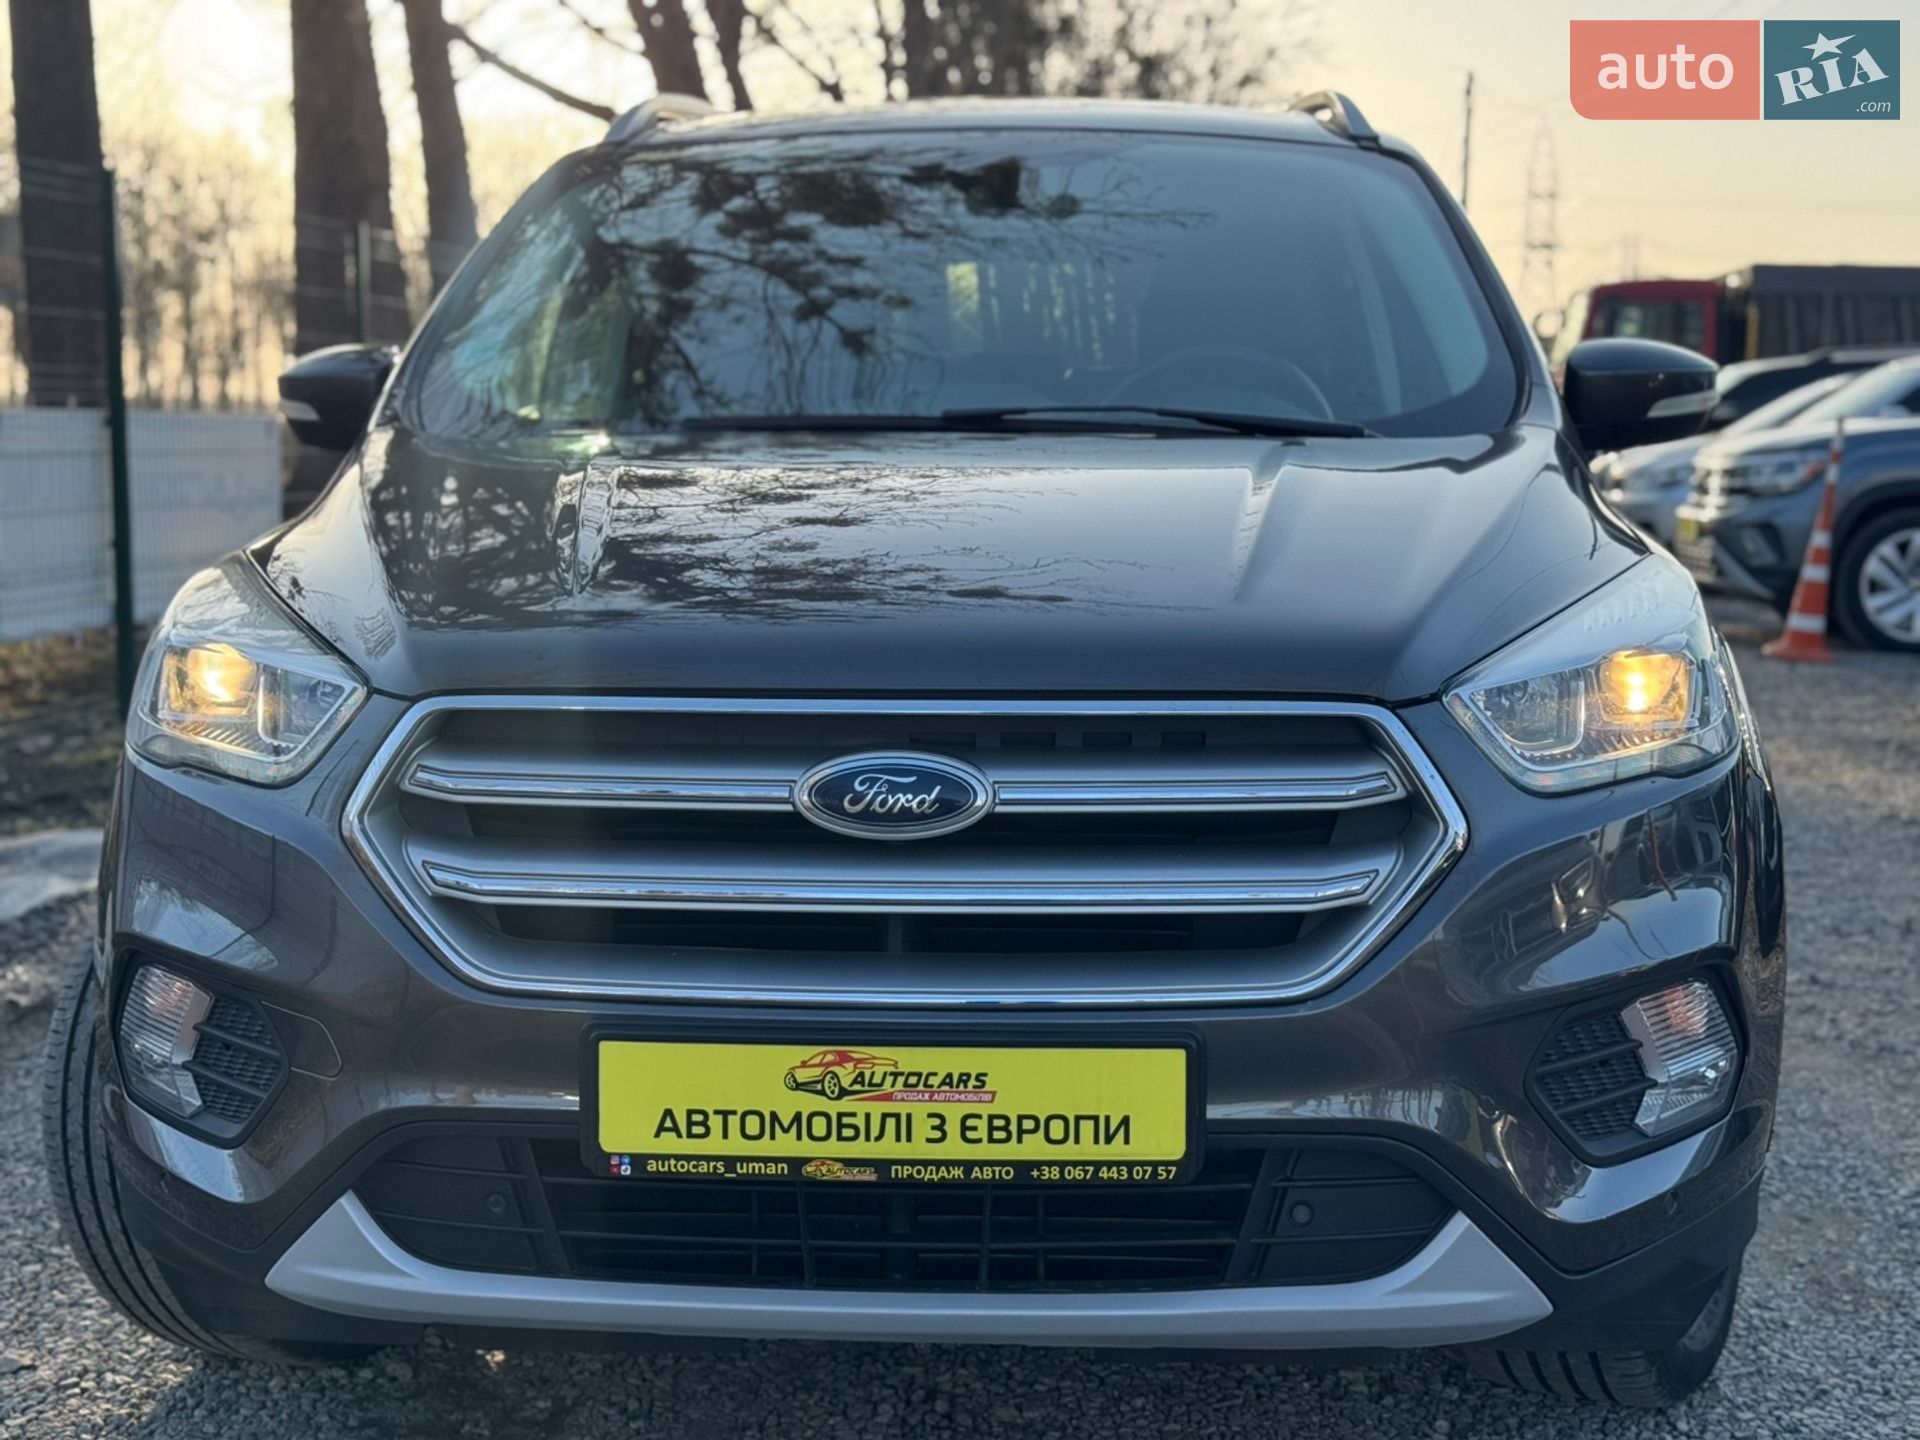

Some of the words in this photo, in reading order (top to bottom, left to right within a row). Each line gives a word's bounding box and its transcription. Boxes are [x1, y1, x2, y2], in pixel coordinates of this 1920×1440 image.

[843, 773, 942, 815] Ford
[848, 1070, 989, 1090] AUTOCARS
[653, 1107, 913, 1143] АВТОМОБІЛІ
[959, 1113, 1131, 1146] ЄВРОПИ
[646, 1157, 789, 1178] autocars_uman
[891, 1165, 964, 1181] ПРОДАЖ
[970, 1166, 1015, 1181] АВТО
[1030, 1167, 1060, 1181] +38
[1064, 1166, 1093, 1181] 067
[1098, 1167, 1128, 1181] 443
[1133, 1167, 1152, 1181] 07
[1157, 1167, 1177, 1181] 57
